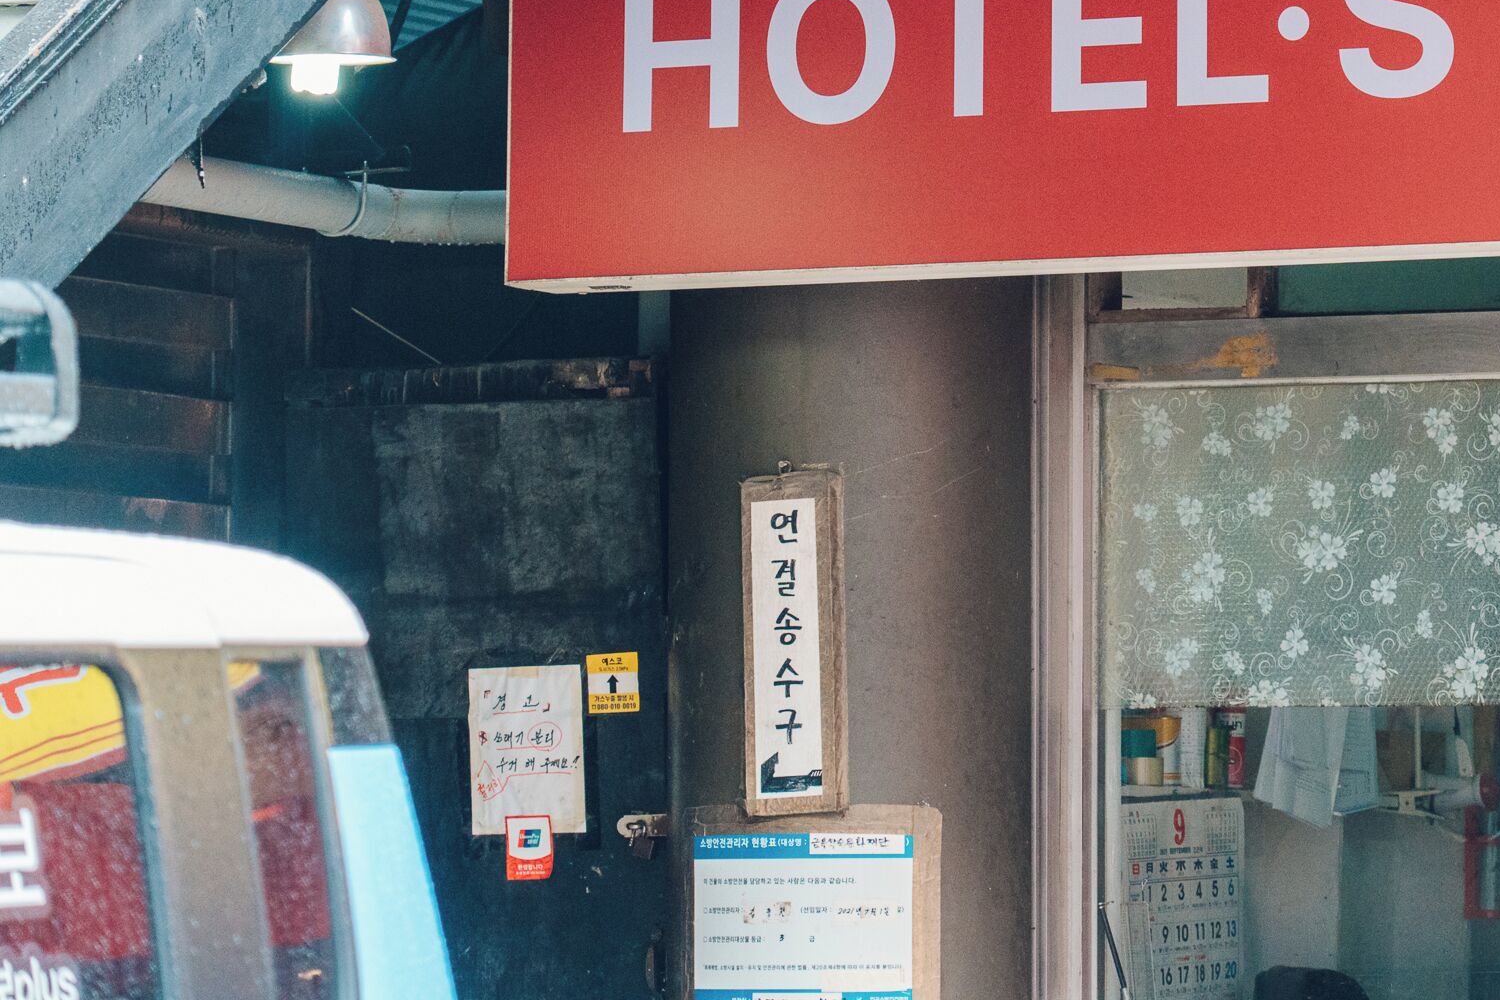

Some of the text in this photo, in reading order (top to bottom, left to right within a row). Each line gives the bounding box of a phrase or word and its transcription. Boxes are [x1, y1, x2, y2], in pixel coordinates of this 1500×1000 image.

[770, 510, 804, 745] 연결송수구
[601, 657, 623, 666] 예스코
[1173, 807, 1186, 846] 9
[751, 837, 777, 849] 현황표
[1132, 855, 1235, 875] 日 月 火 水 木 金 土
[1161, 884, 1168, 901] 2
[1177, 882, 1185, 900] 3
[1195, 880, 1203, 899] 4
[1211, 880, 1219, 898] 5
[1228, 877, 1235, 896] 6
[1162, 919, 1237, 943] 9 10 11 12 13
[1160, 960, 1237, 986] 16 17 18 19 20
